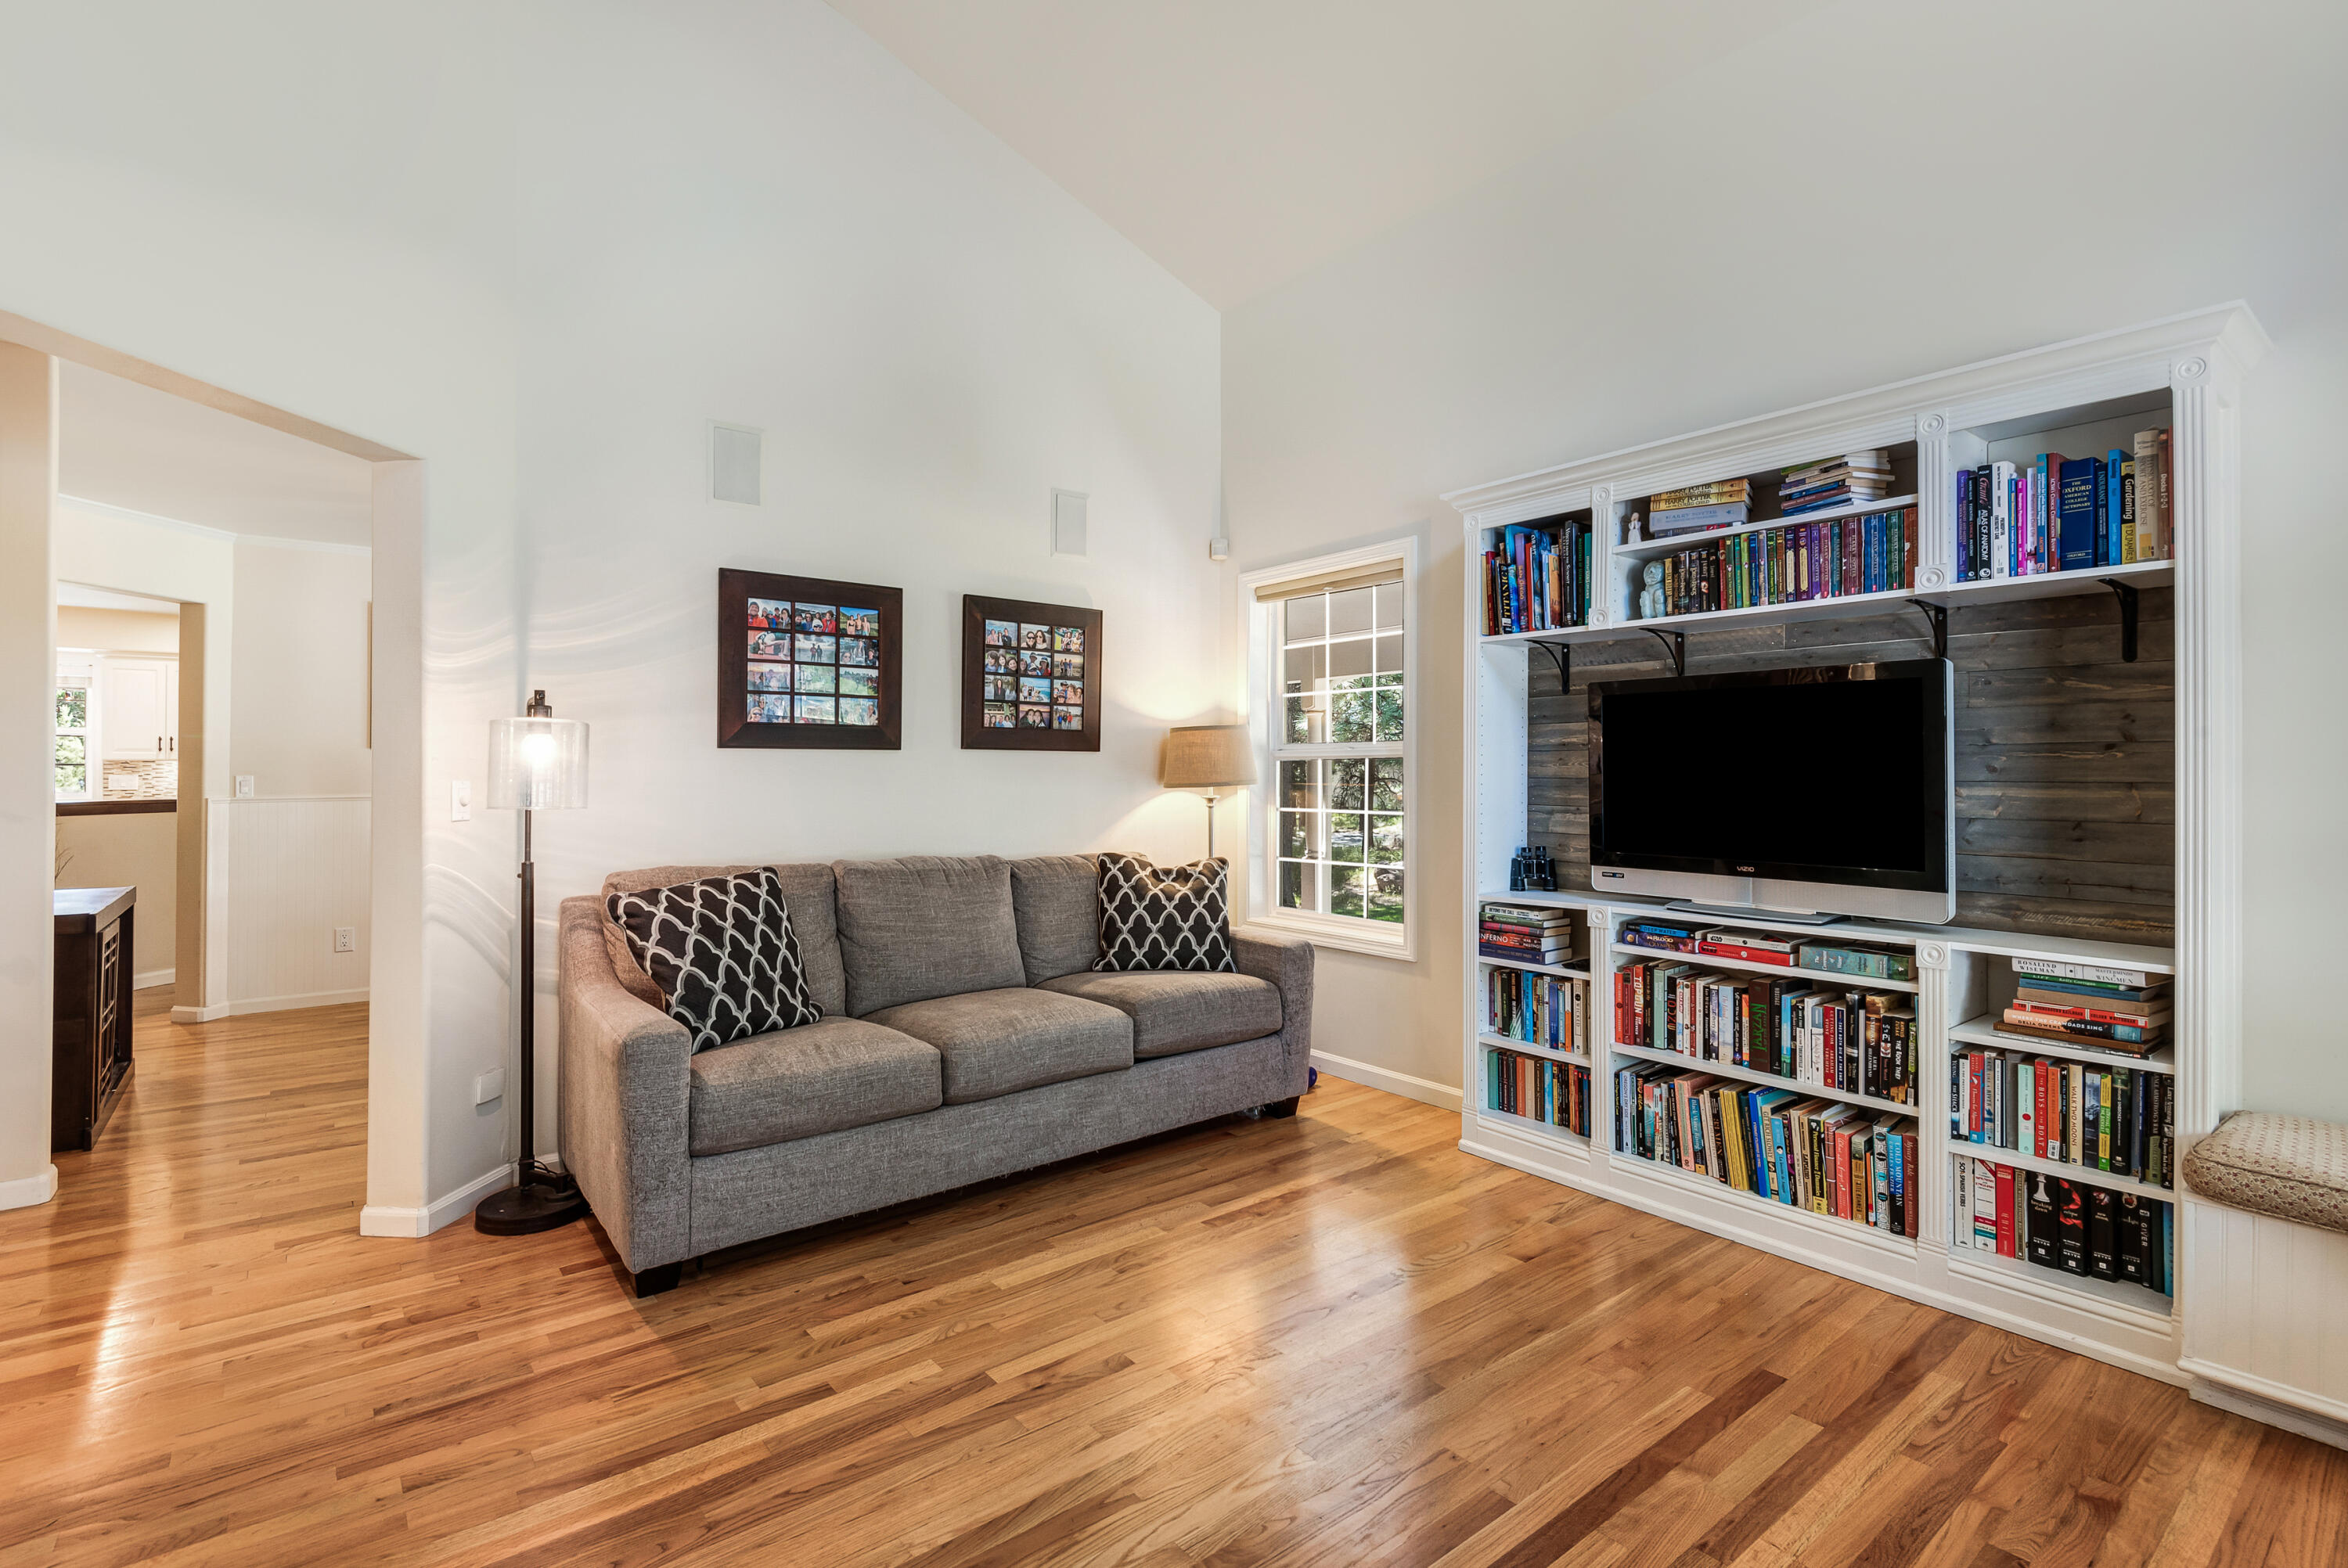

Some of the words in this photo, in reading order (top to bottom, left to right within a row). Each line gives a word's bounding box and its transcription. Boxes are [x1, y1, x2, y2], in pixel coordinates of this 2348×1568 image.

[2062, 484, 2091, 494] OXFORD
[2123, 478, 2134, 520] Gardening
[2139, 495, 2148, 527] EXERCISE
[1501, 572, 1511, 618] TITANIC
[2018, 960, 2057, 969] ROSALIND
[2019, 966, 2055, 974] WISEMAN
[2096, 975, 2134, 984] WINGMEN
[2049, 1019, 2085, 1029] CRAWDADS
[1904, 1140, 1913, 1161] Mystery
